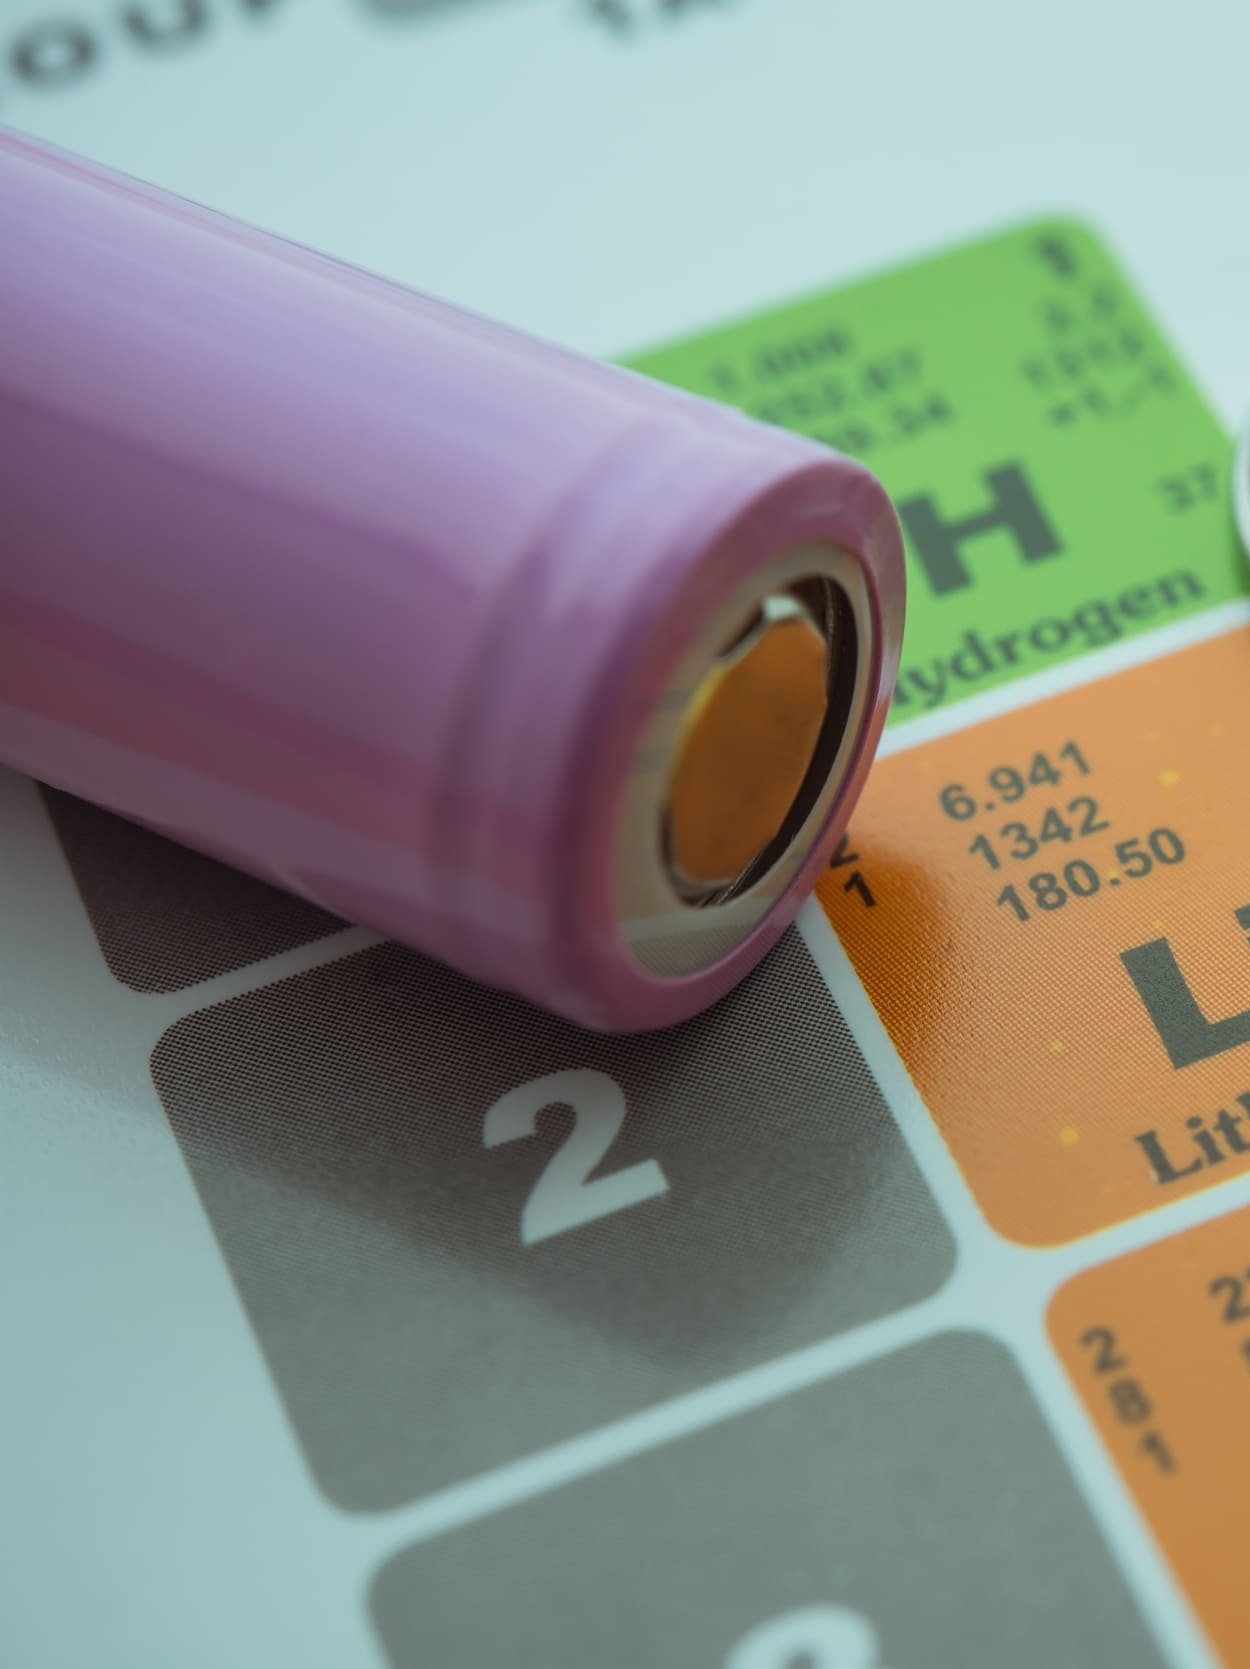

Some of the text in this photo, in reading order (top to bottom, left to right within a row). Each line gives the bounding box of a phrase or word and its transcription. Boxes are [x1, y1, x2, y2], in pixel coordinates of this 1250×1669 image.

[1157, 463, 1220, 515] 37
[903, 460, 1064, 598] H
[893, 566, 1206, 710] ydrogen
[938, 740, 1092, 824] 6.941
[968, 796, 1111, 872] 1342
[843, 870, 876, 908] 1
[995, 826, 1187, 923] 180.50
[483, 1067, 671, 1248] 2
[1079, 1325, 1127, 1376] 2
[1107, 1377, 1152, 1427] 8
[1136, 1432, 1179, 1477] 1
